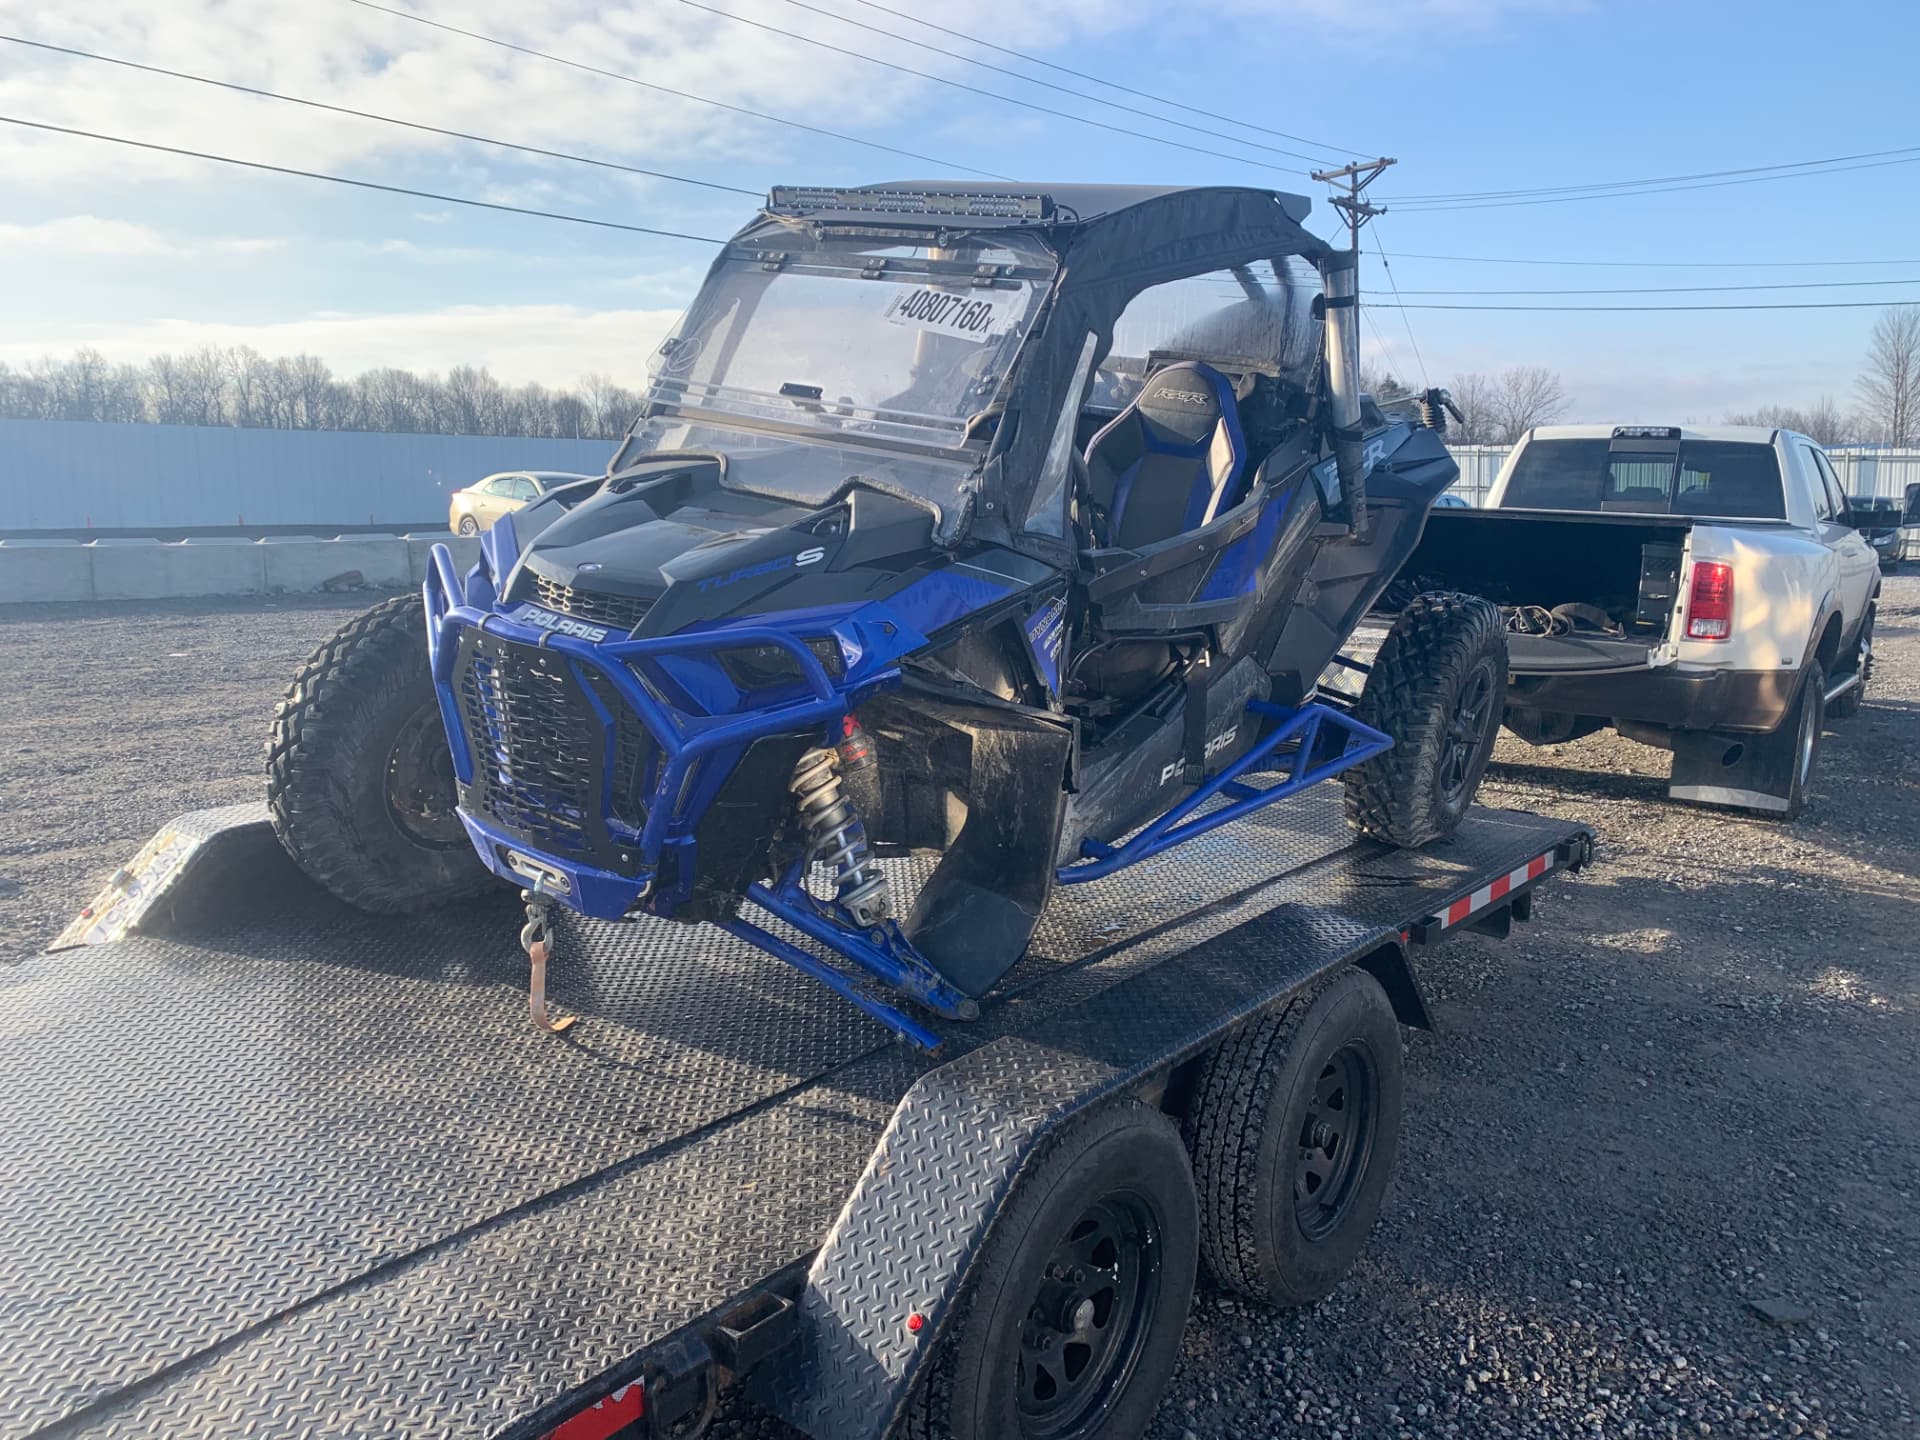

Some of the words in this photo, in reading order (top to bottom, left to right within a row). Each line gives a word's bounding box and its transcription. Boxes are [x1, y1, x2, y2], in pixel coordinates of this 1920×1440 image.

[795, 546, 825, 567] S
[522, 608, 608, 642] POLARIS
[1160, 724, 1238, 786] POARIS
